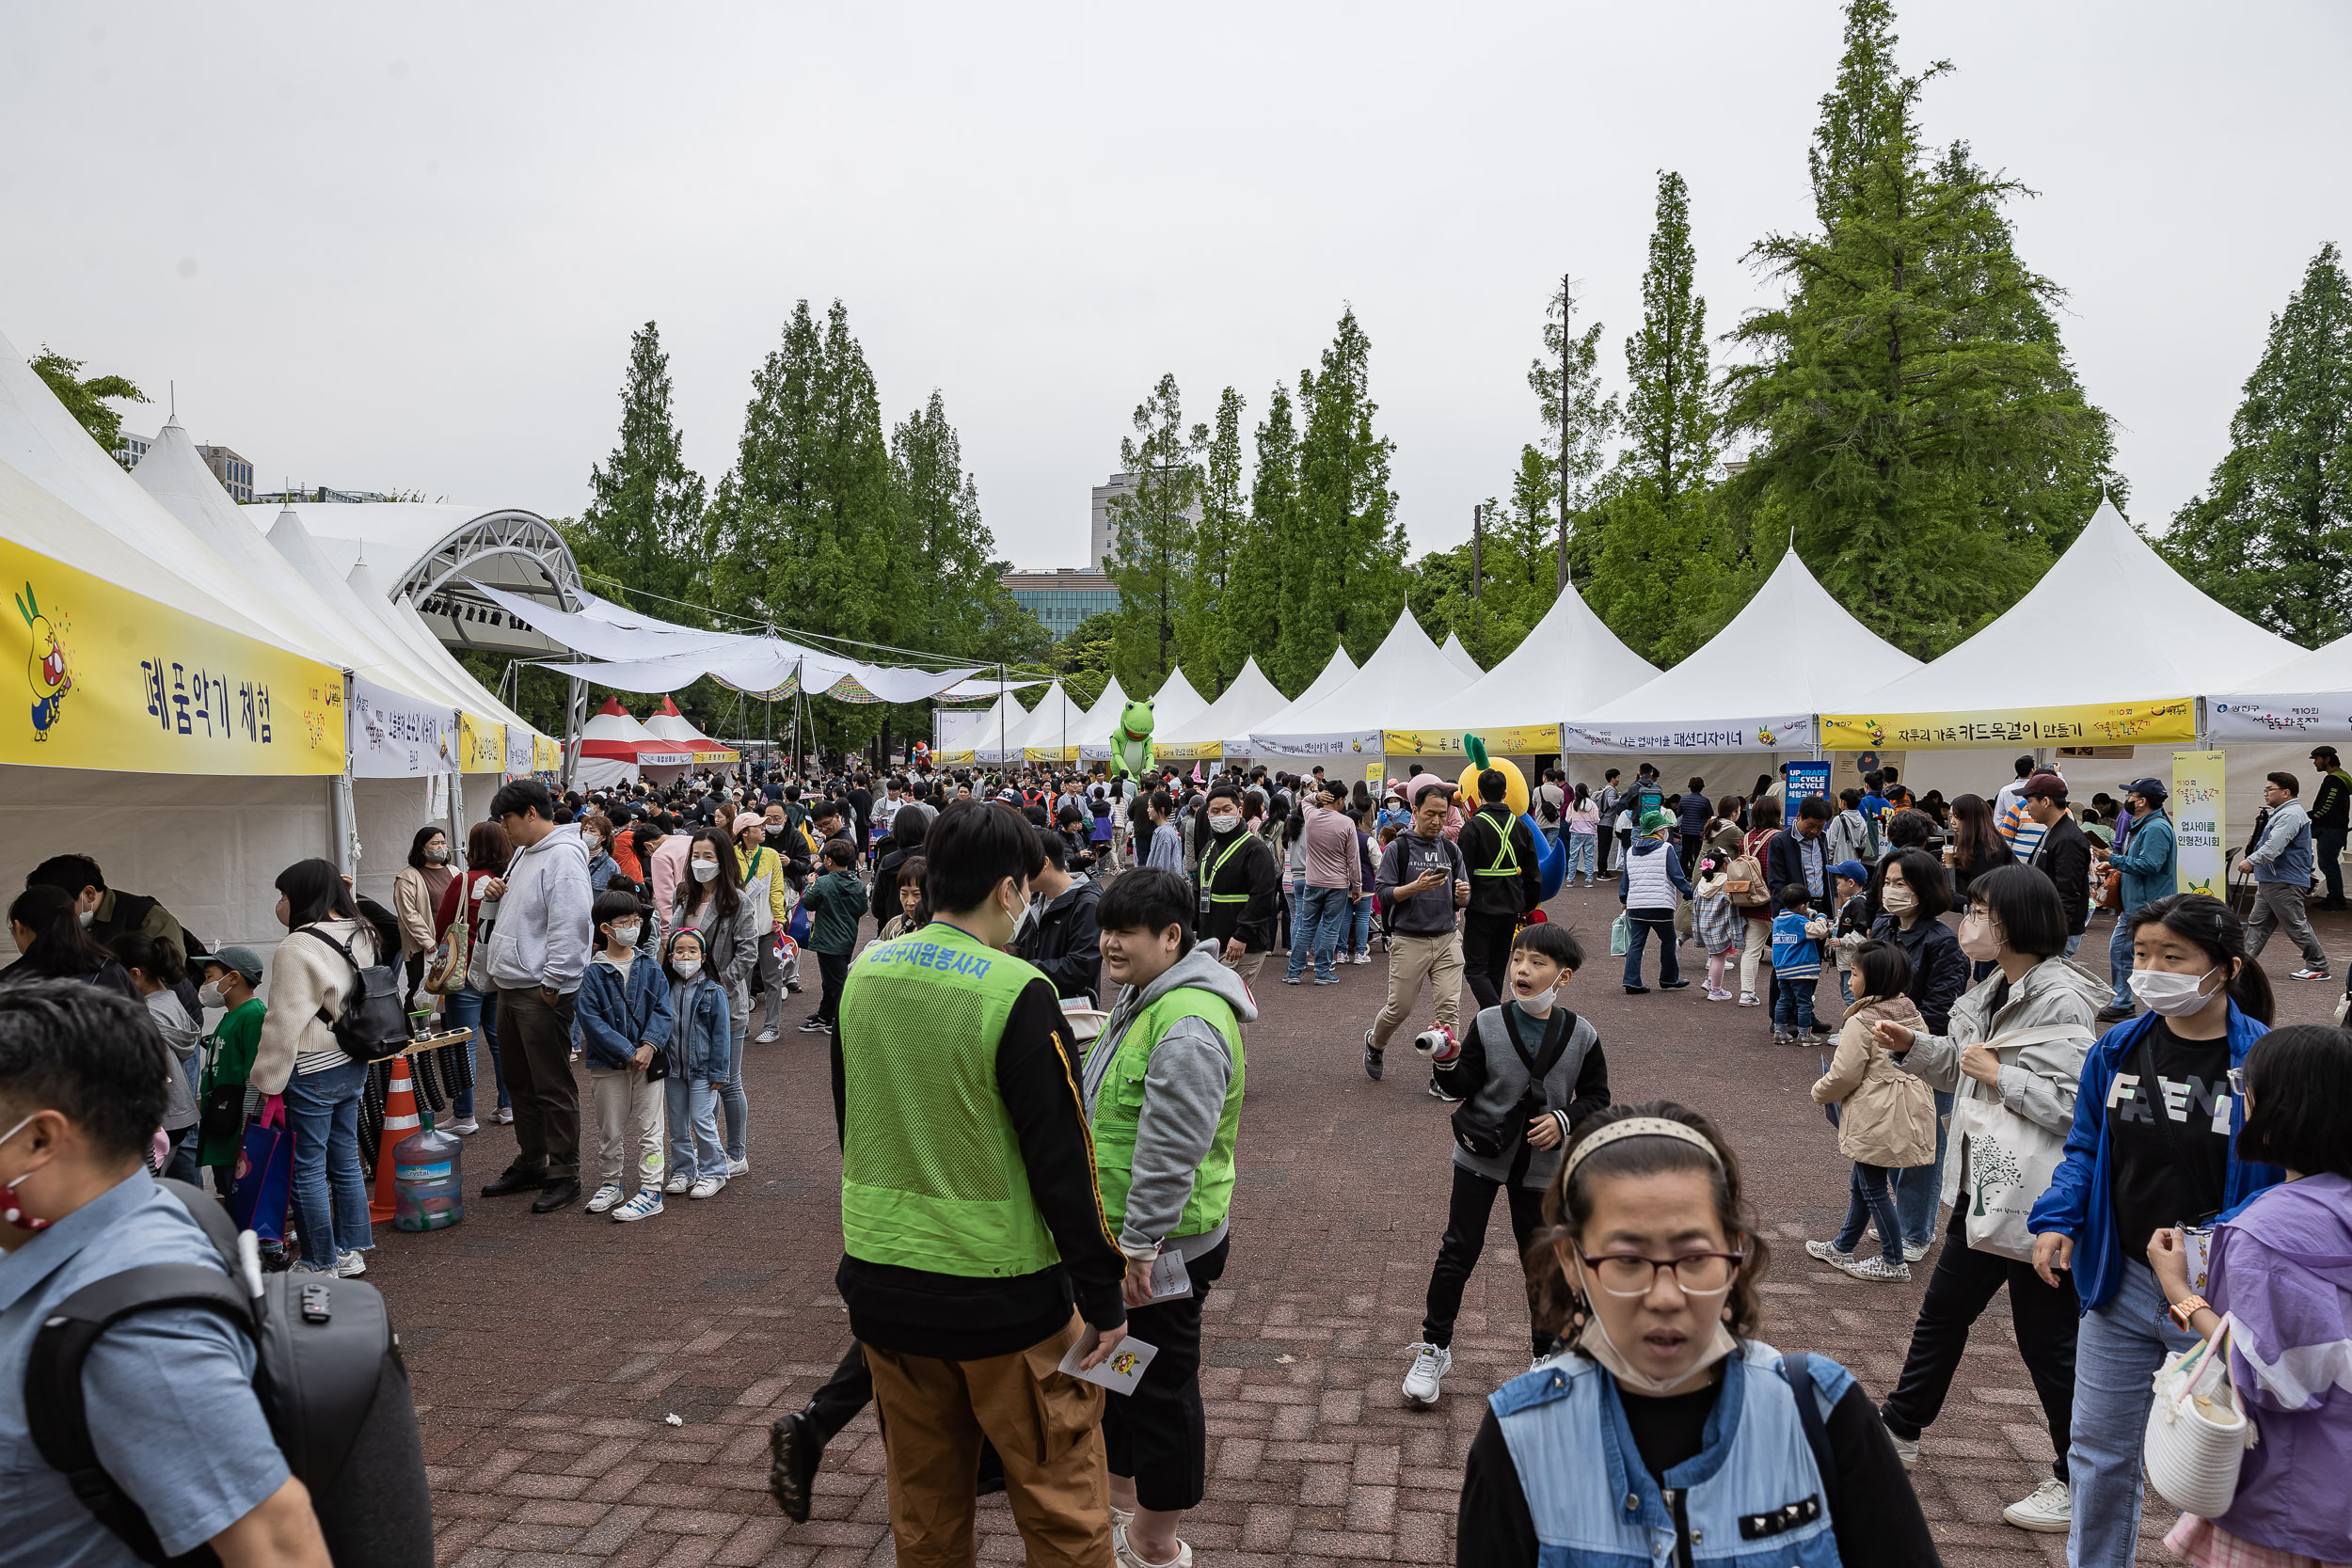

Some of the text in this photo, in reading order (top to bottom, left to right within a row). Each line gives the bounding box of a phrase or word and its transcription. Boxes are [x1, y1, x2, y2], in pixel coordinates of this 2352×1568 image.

[141, 657, 271, 743] 폐품악기 체험
[2231, 705, 2260, 713] 광진구
[1619, 730, 1742, 748] 나는 업싸이클 패션디자이너
[1899, 721, 2083, 742] 자투리 가죽 카드목걸이 만들기
[2181, 821, 2216, 832] 업사이클
[2177, 835, 2220, 847] 인형전시회
